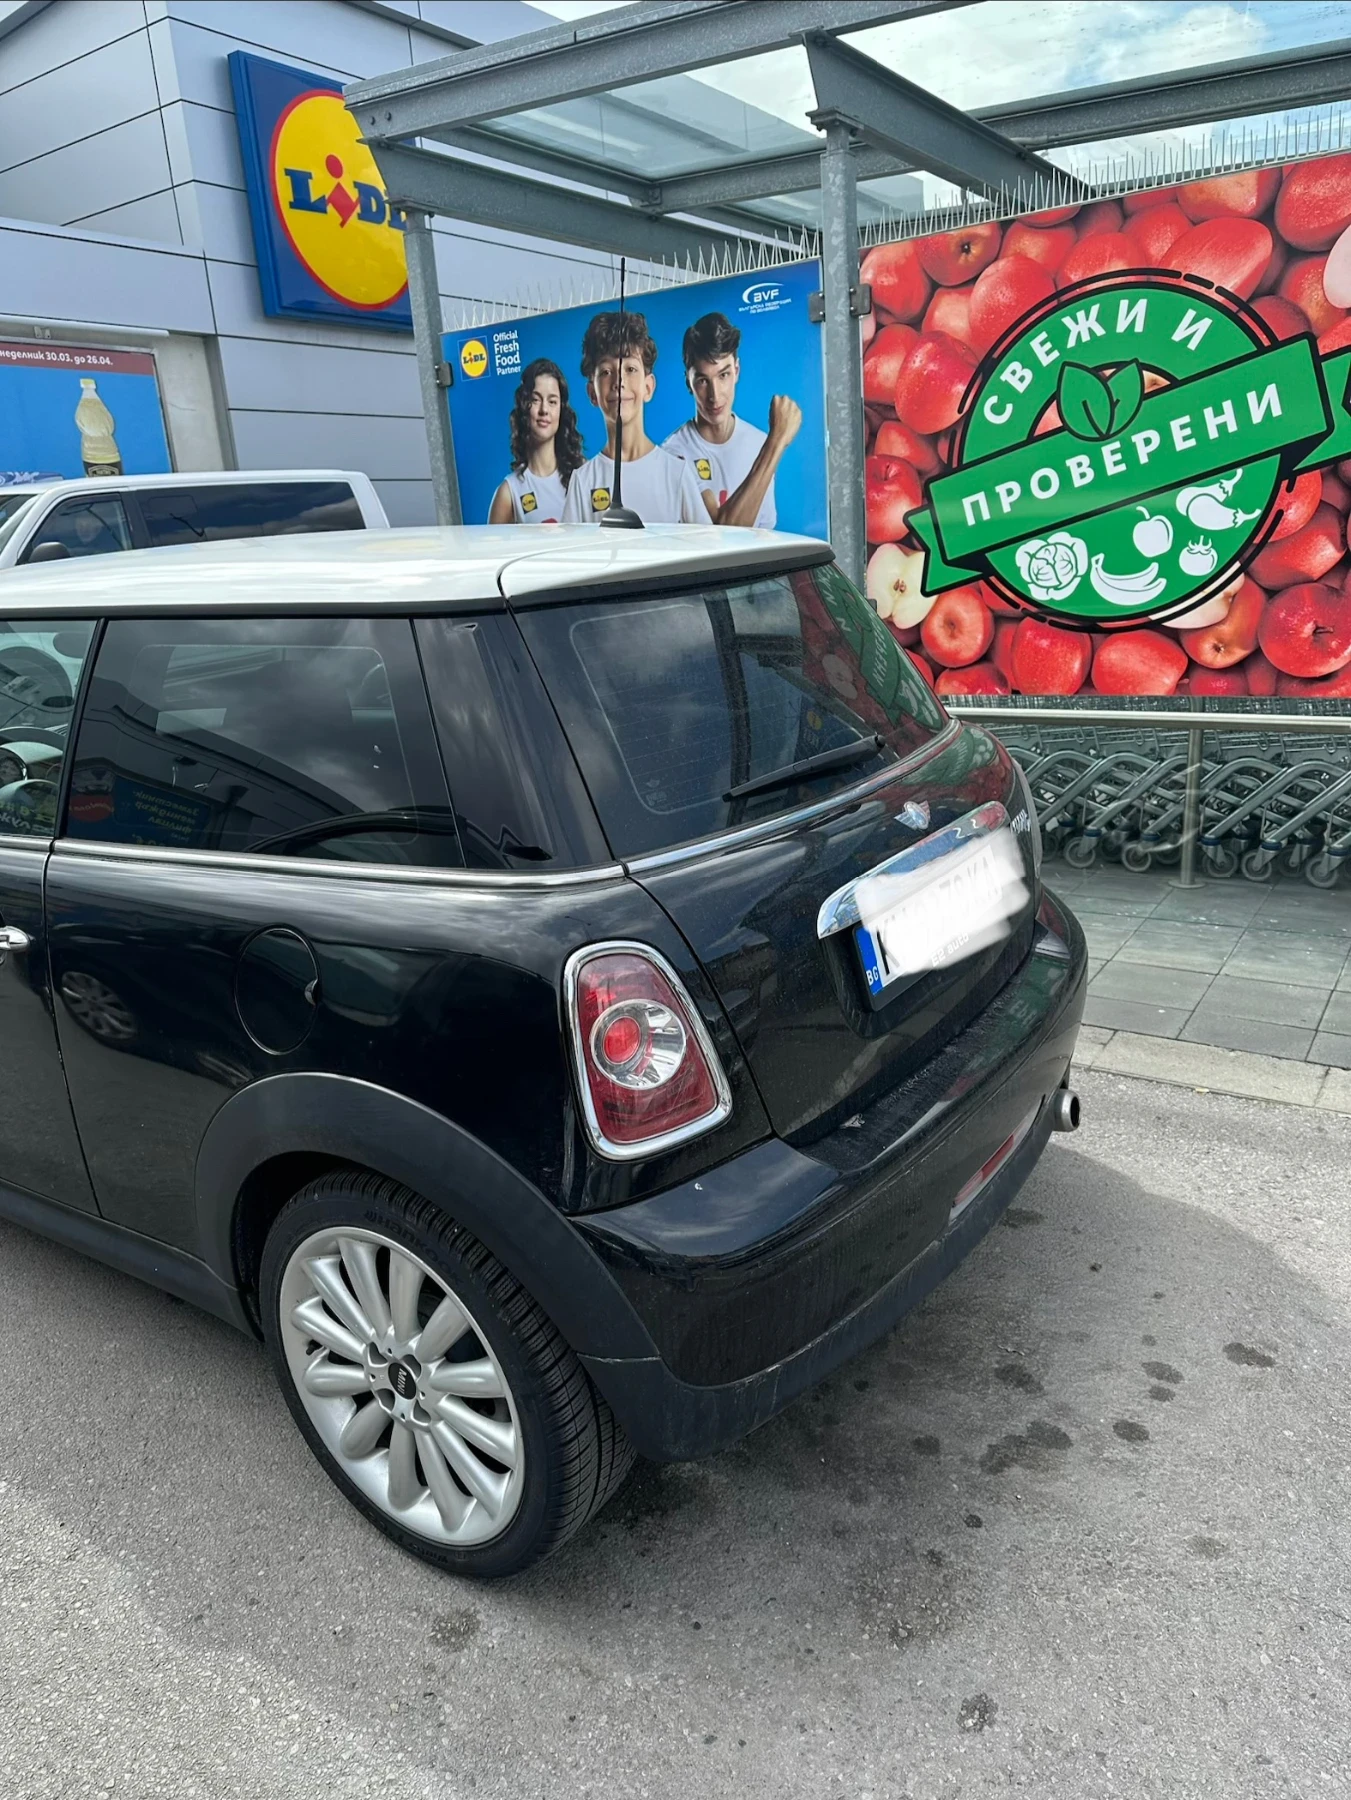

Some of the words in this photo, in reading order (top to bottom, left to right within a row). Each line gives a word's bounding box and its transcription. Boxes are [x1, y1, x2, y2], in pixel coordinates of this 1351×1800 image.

[493, 330, 518, 342] Official
[494, 340, 519, 354] Fresh
[45, 352, 73, 363] 30.03.
[86, 355, 113, 365] 26.04.
[495, 350, 521, 367] Food
[983, 298, 1148, 425] СВЕЖИ
[1170, 308, 1213, 351] И
[496, 365, 521, 376] Partner
[961, 382, 1282, 527] ПРОВЕРЕНИ
[866, 966, 879, 986] BG
[396, 1367, 407, 1395] MINI
